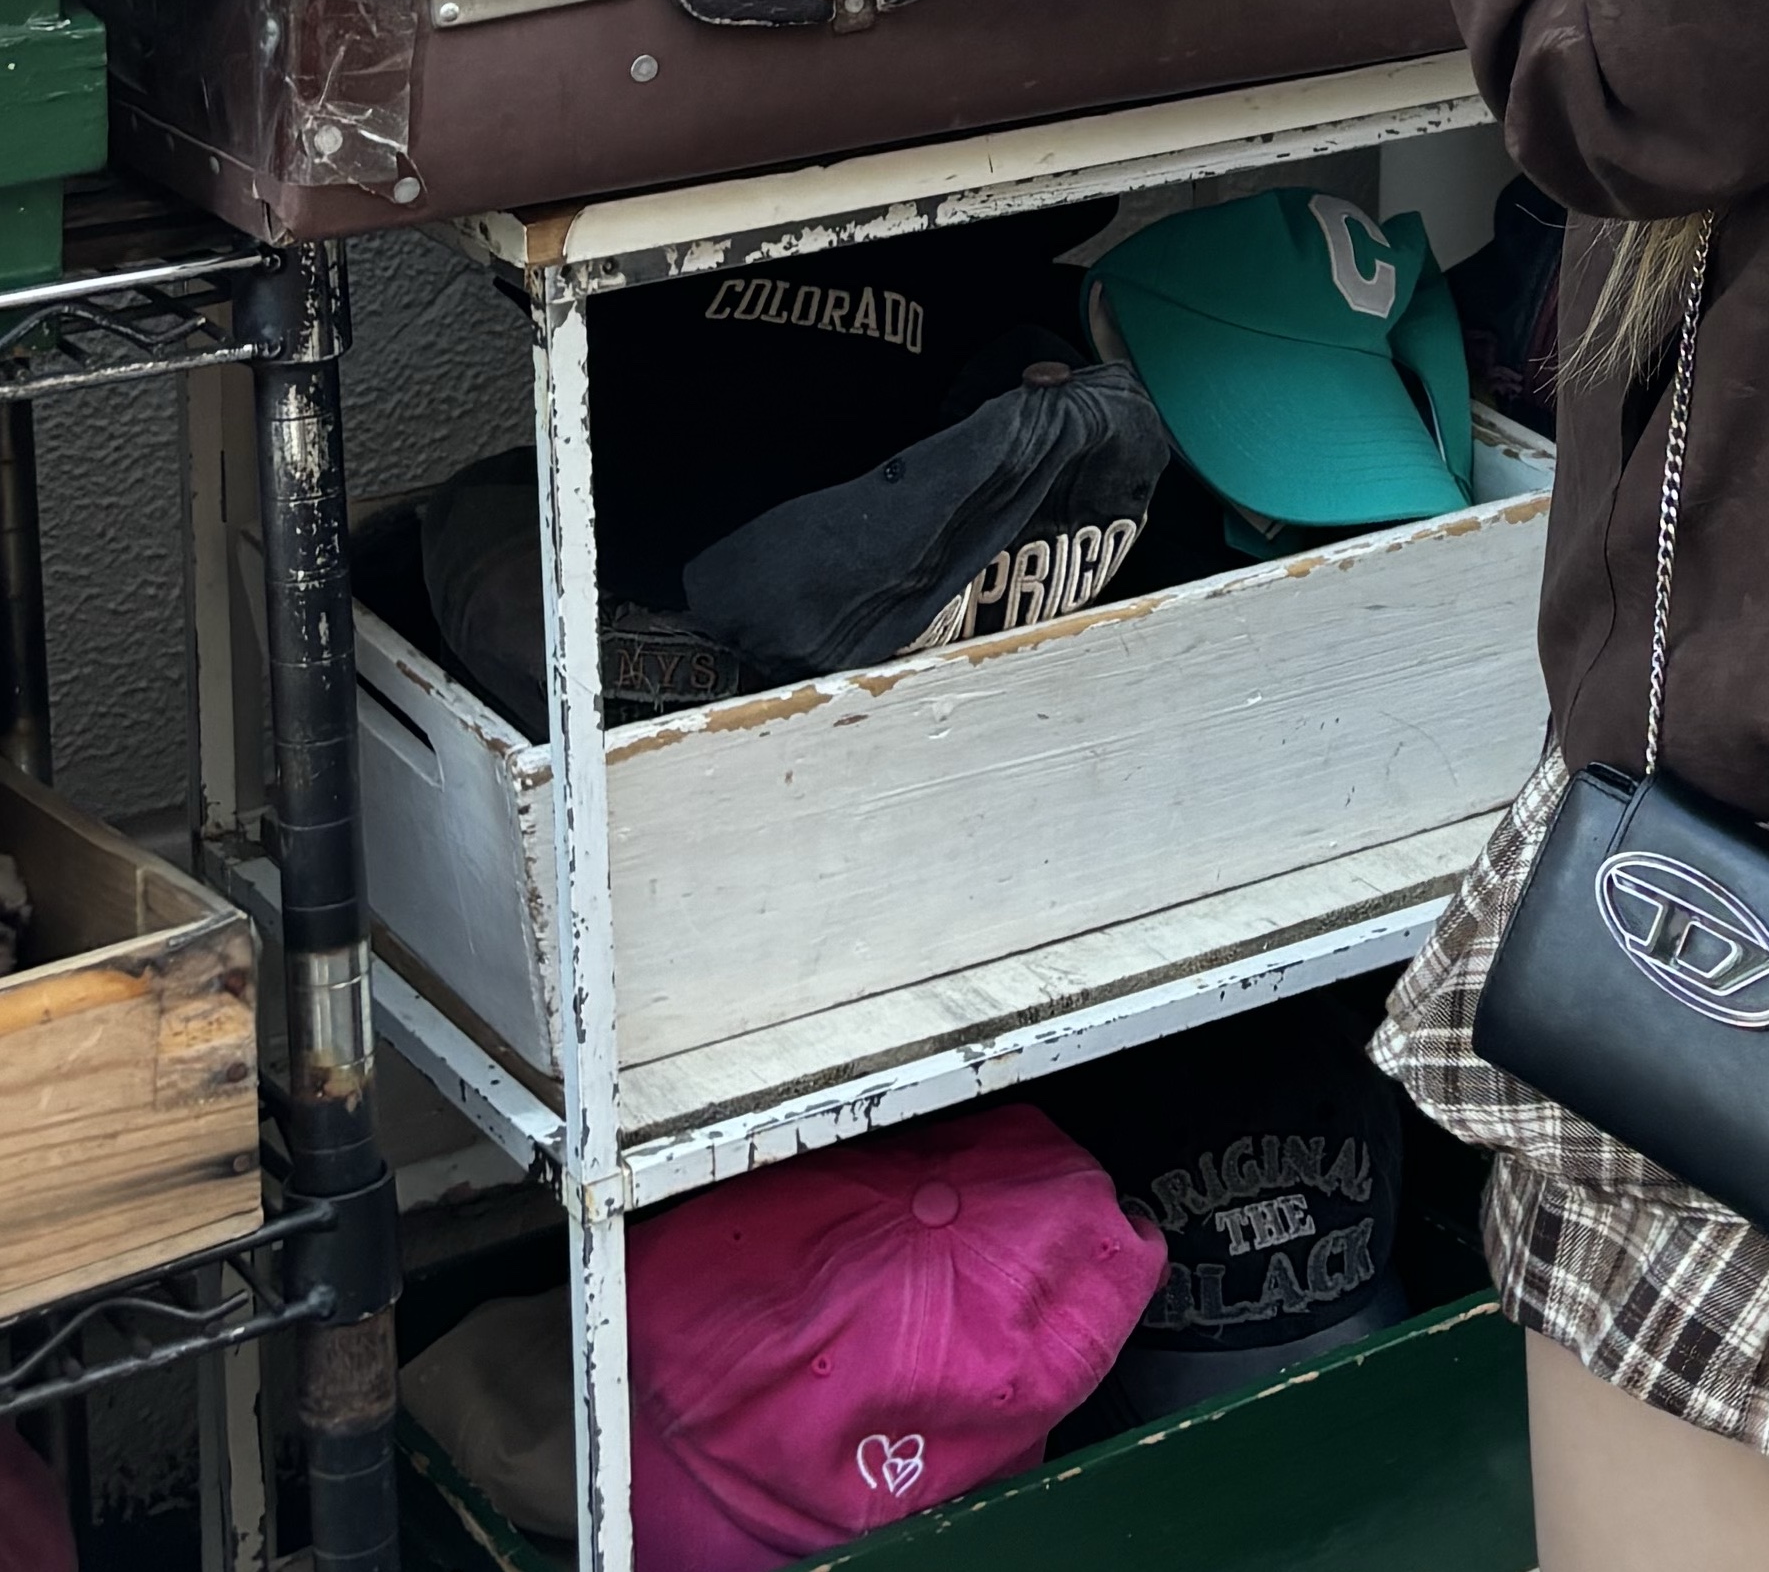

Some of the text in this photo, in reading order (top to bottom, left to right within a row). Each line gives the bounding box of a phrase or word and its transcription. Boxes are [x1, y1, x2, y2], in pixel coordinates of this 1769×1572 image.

[1307, 193, 1396, 319] C
[704, 278, 924, 354] COLORADO
[1214, 1193, 1317, 1257] THE
[1142, 1217, 1376, 1330] BLACK
